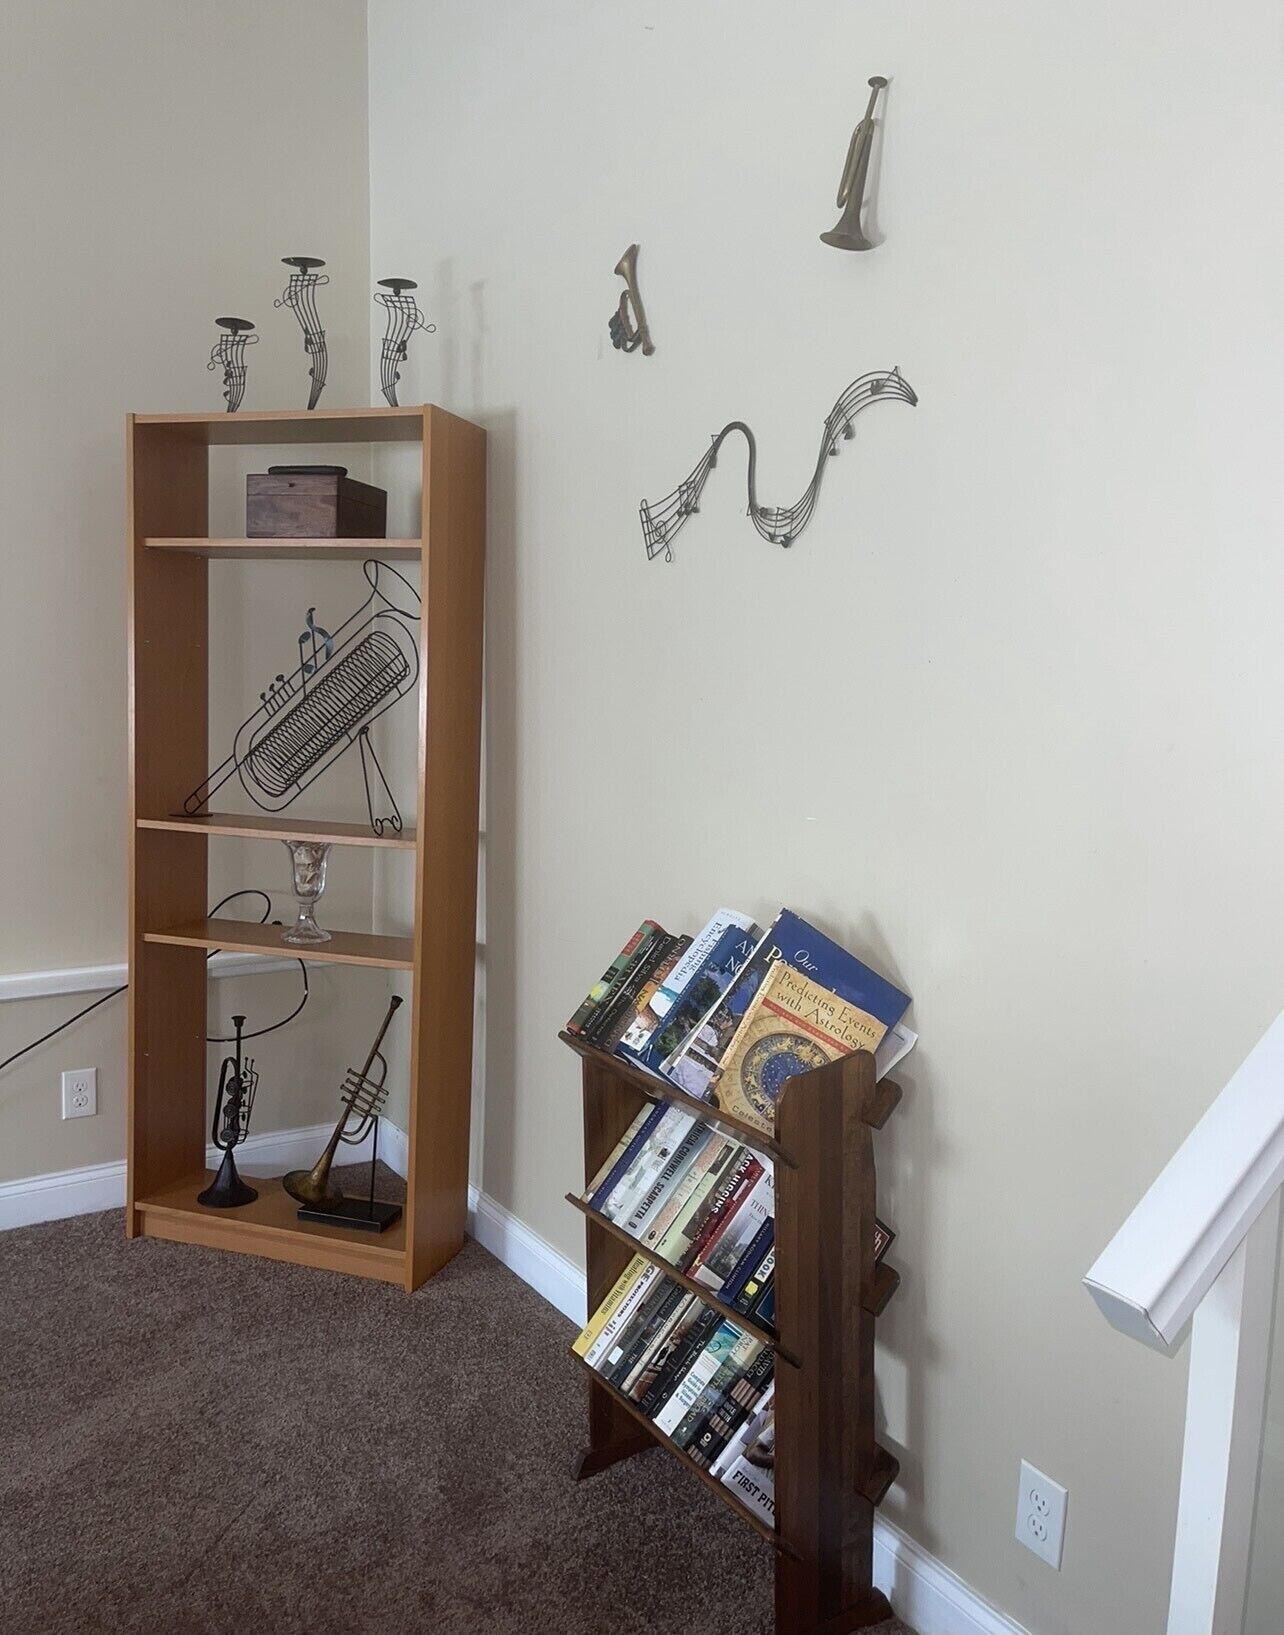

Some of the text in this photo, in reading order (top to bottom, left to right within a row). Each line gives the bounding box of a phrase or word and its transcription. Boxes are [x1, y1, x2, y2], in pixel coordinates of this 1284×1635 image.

[648, 934, 671, 963] Daniel
[672, 918, 722, 984] Encyclopedia
[791, 946, 823, 974] Our
[633, 962, 650, 984] Silva
[777, 970, 880, 1039] Predicting Events
[775, 986, 869, 1052] with Astrology
[660, 1144, 689, 1182] CORNWELL
[737, 1153, 754, 1173] ACK
[633, 1180, 664, 1220] SCARPETTA
[709, 1172, 740, 1214] HIGGINS
[623, 1256, 644, 1282] Healing
[639, 1263, 656, 1282] GE
[617, 1278, 629, 1291] with
[600, 1288, 622, 1316] Vitamins
[695, 1338, 705, 1350] The
[745, 1345, 771, 1379] ALDACCI
[754, 1349, 776, 1377] DAVID
[731, 1469, 775, 1514] FIRST PIT
